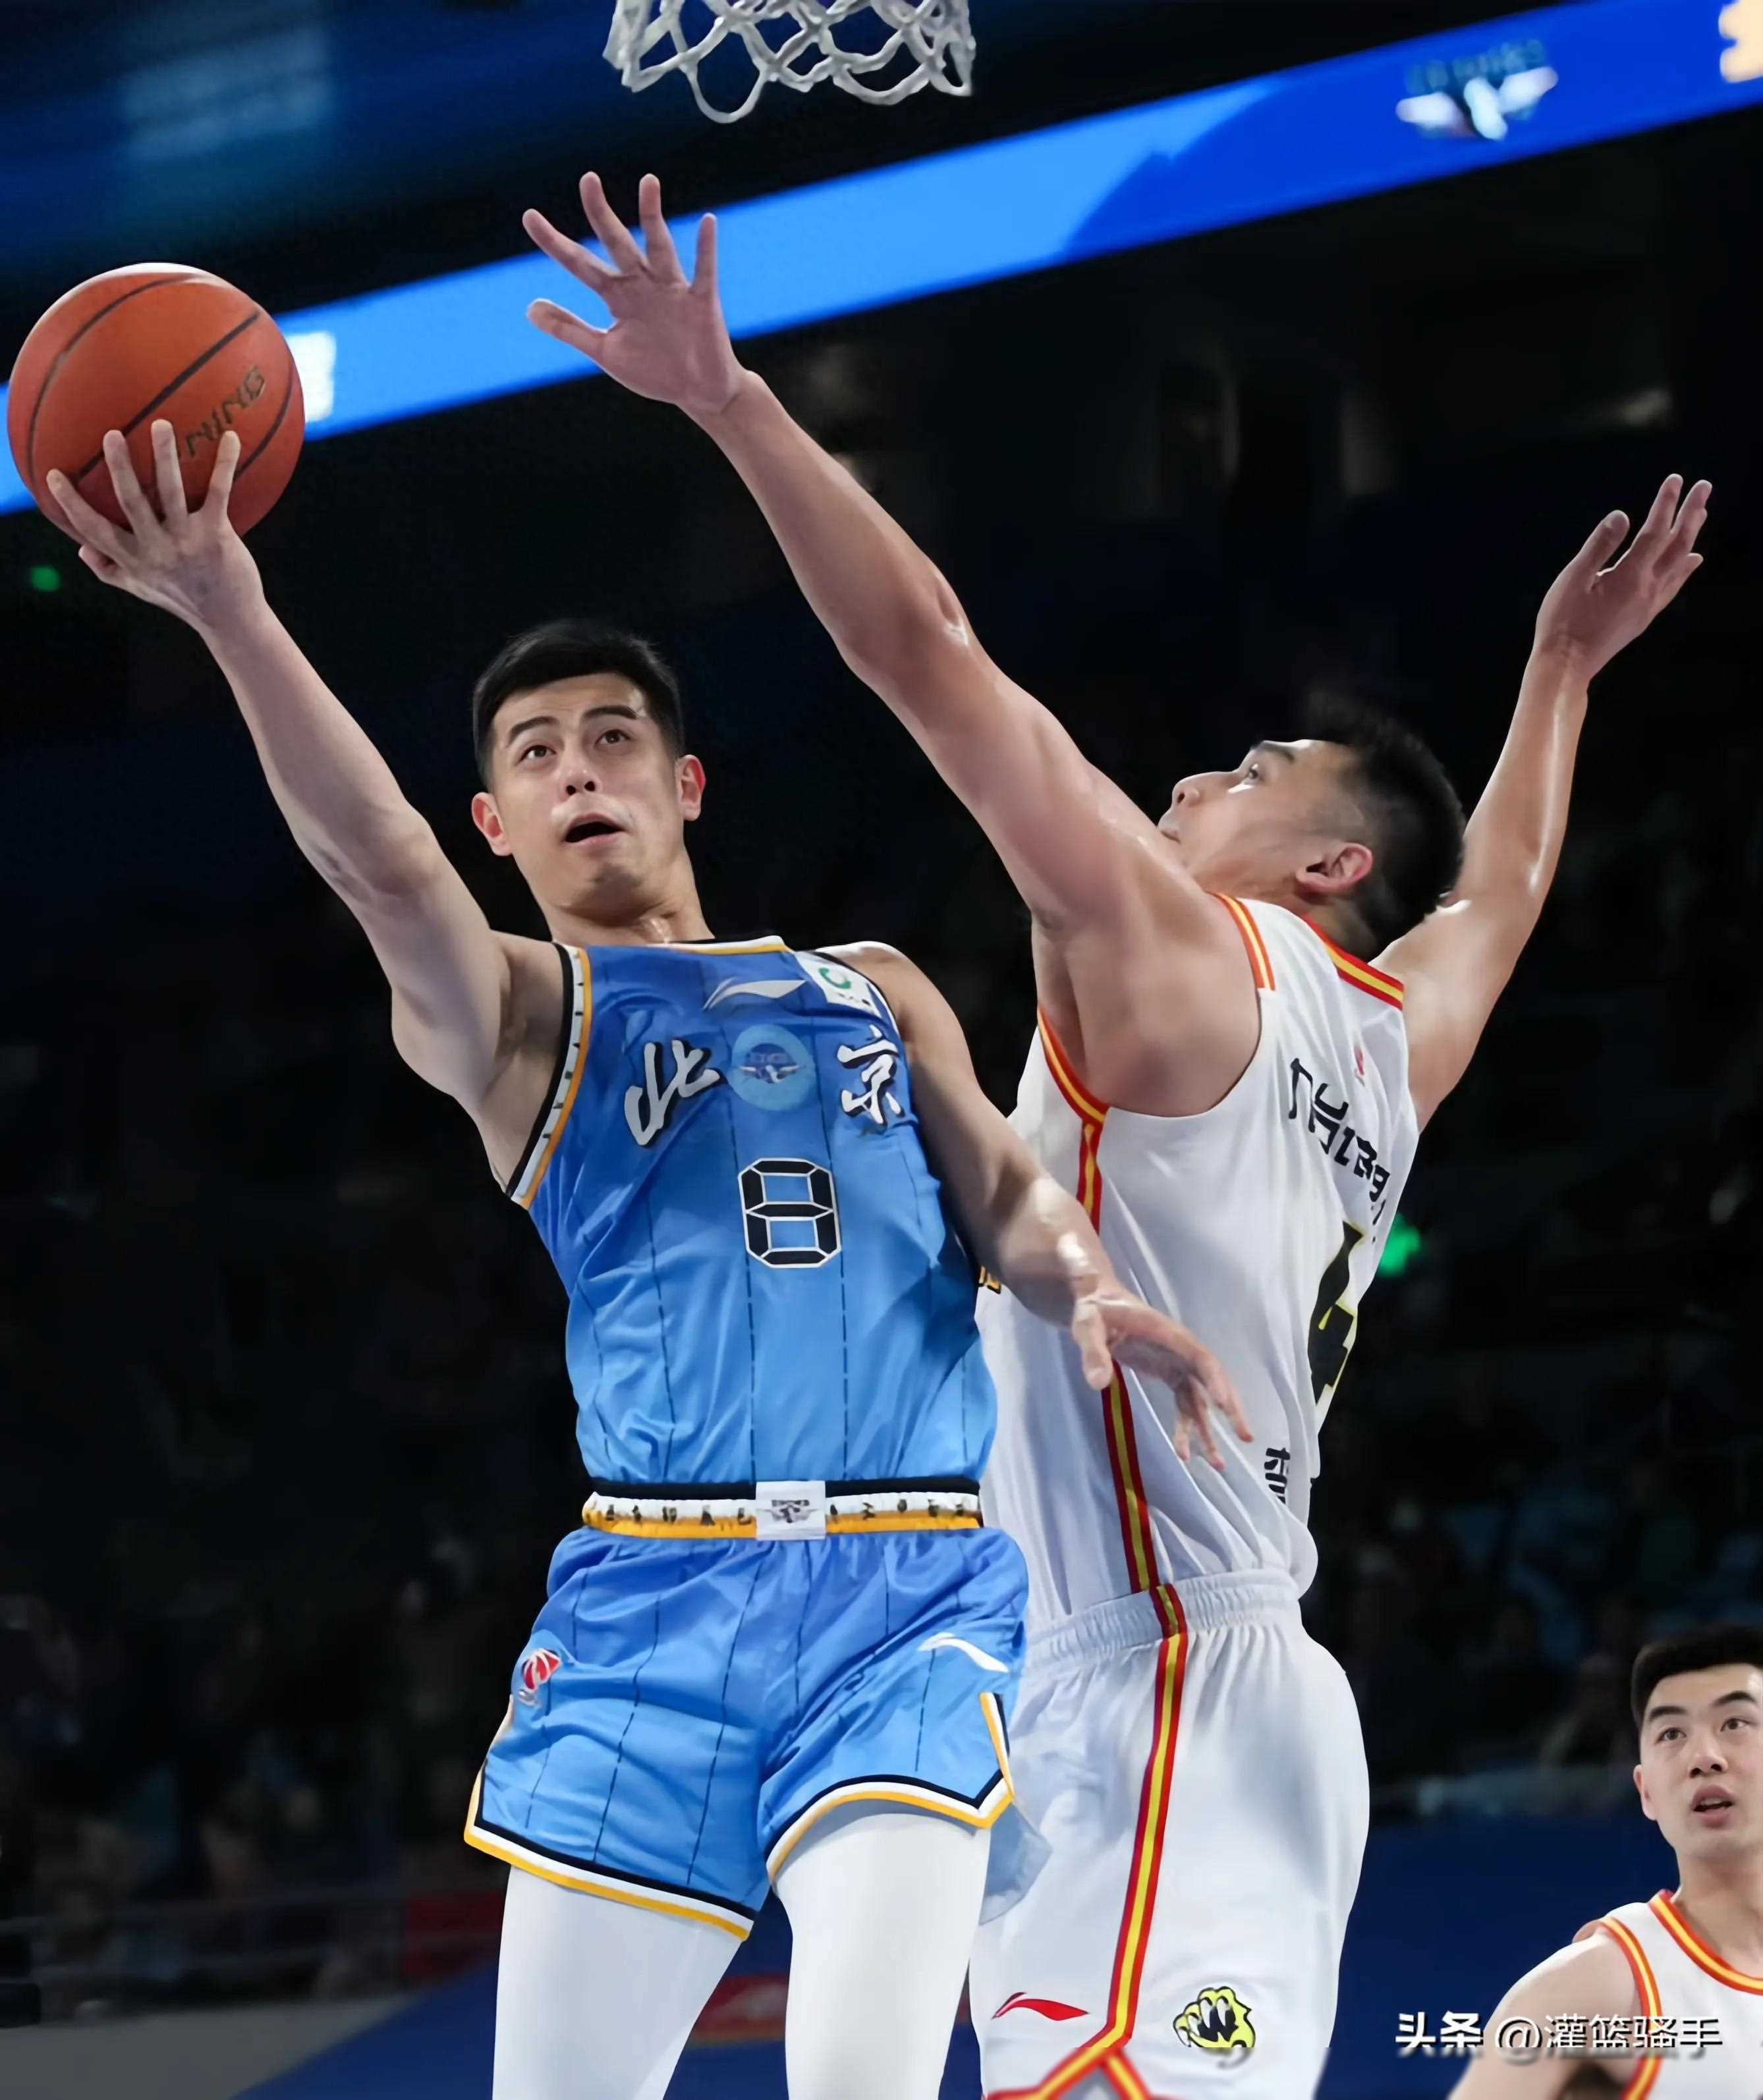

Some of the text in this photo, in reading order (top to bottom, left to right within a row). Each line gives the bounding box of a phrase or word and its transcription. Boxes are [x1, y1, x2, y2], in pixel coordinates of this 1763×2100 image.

[624, 1026, 907, 1147] 北 京
[737, 1157, 842, 1269] 8
